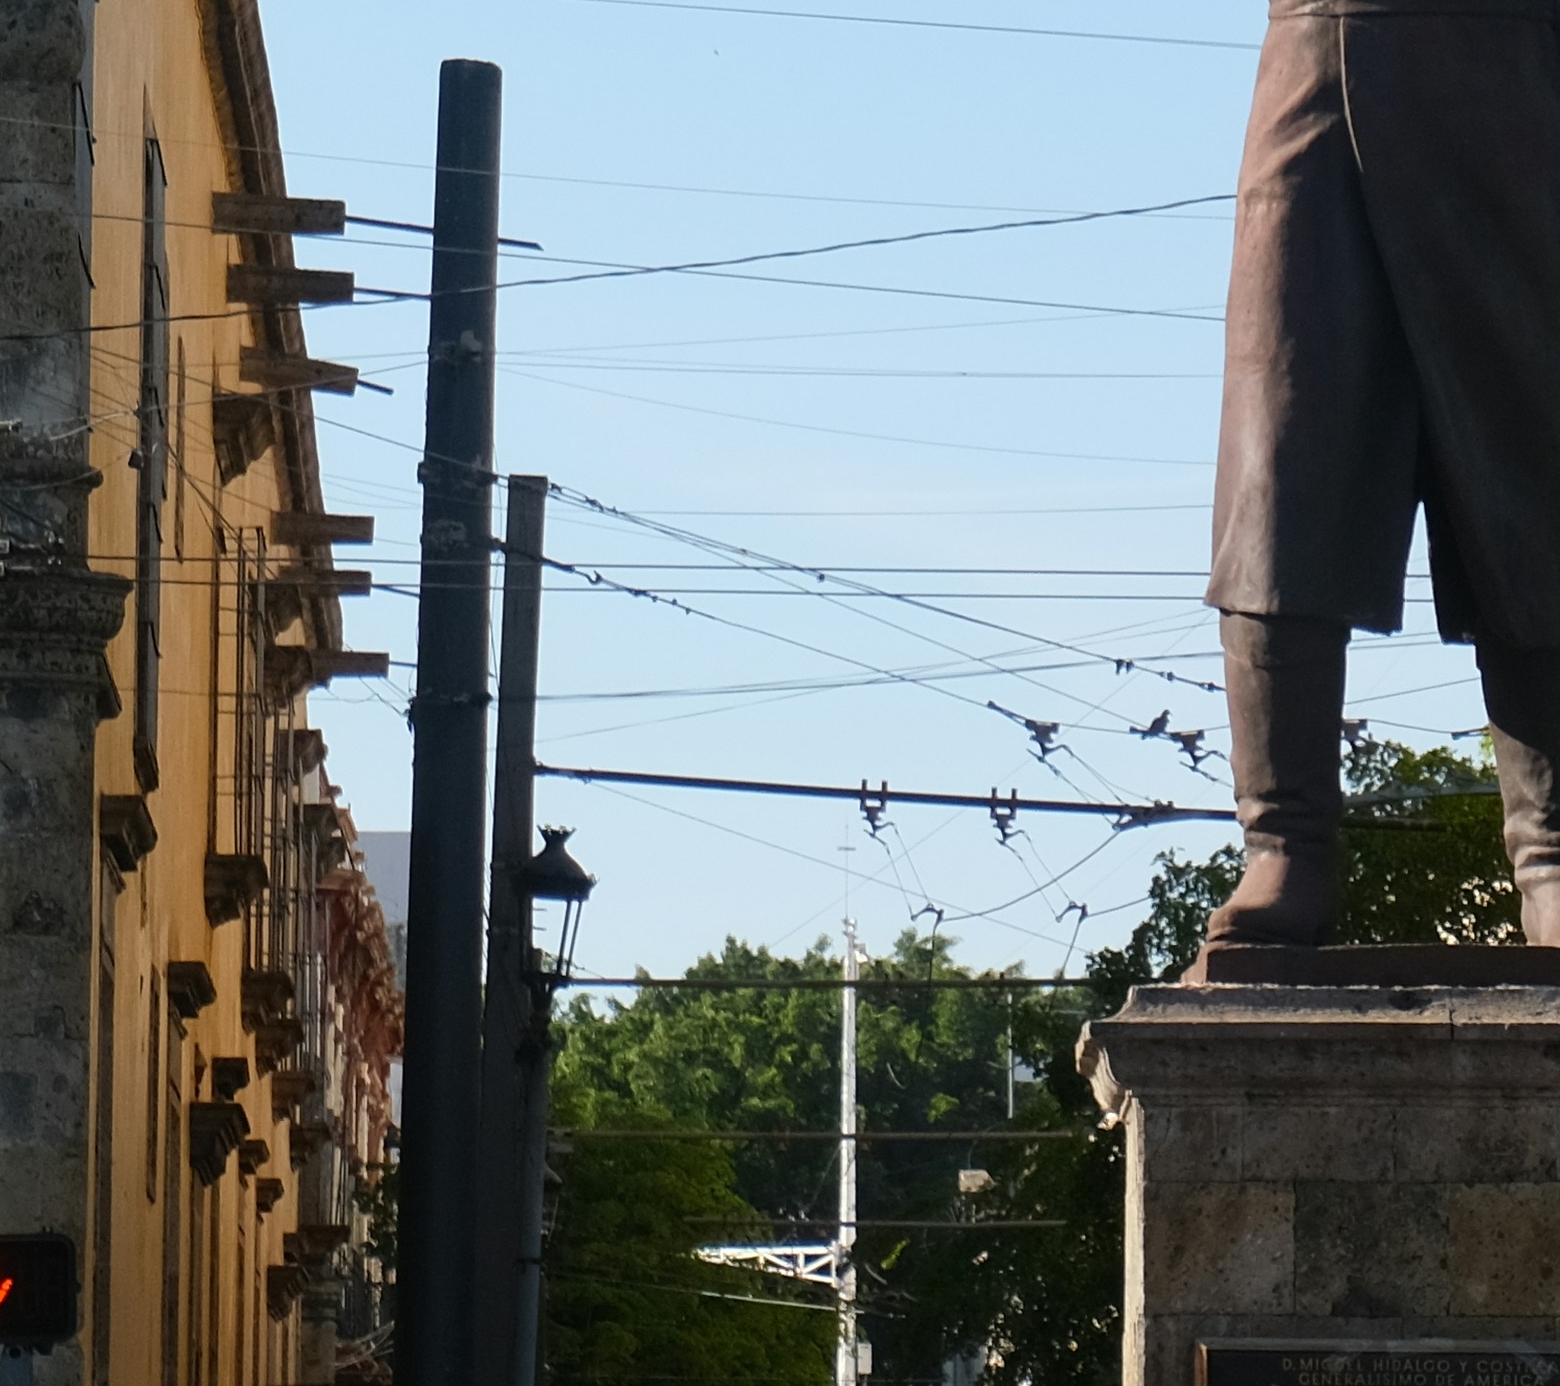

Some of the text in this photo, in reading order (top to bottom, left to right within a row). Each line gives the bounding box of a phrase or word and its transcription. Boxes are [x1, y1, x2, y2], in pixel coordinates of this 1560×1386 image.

[1300, 1359, 1361, 1371] MIGEL
[1298, 1374, 1546, 1386] GENERALISIMO DE AMERICA
